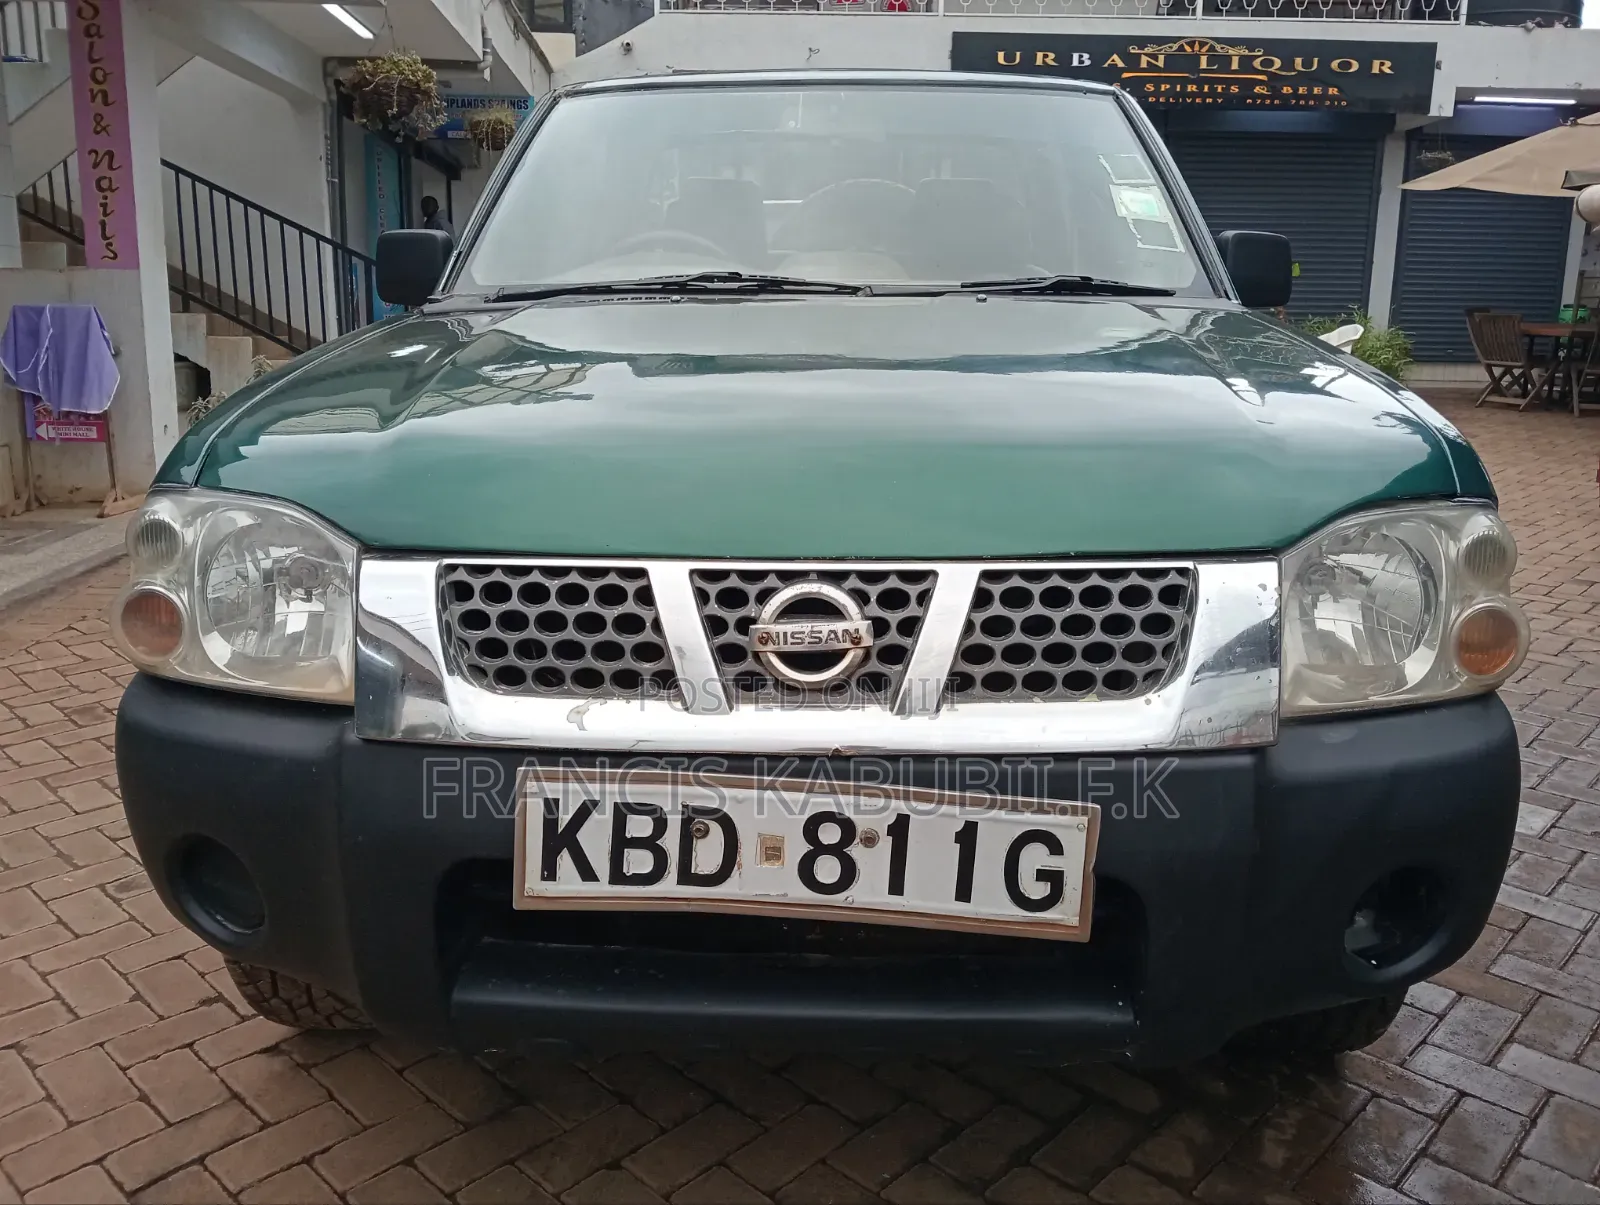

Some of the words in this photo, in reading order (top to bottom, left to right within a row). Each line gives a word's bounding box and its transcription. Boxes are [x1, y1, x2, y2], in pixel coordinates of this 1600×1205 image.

[996, 50, 1166, 69] URBAN
[1198, 54, 1395, 76] LIQUOR
[1144, 83, 1240, 93] SPIRITS
[1253, 85, 1272, 95] &
[1281, 86, 1341, 96] BEER
[93, 113, 111, 137] &
[762, 627, 860, 647] NISSAN
[539, 797, 741, 888] KBD
[797, 810, 1067, 914] 811G
